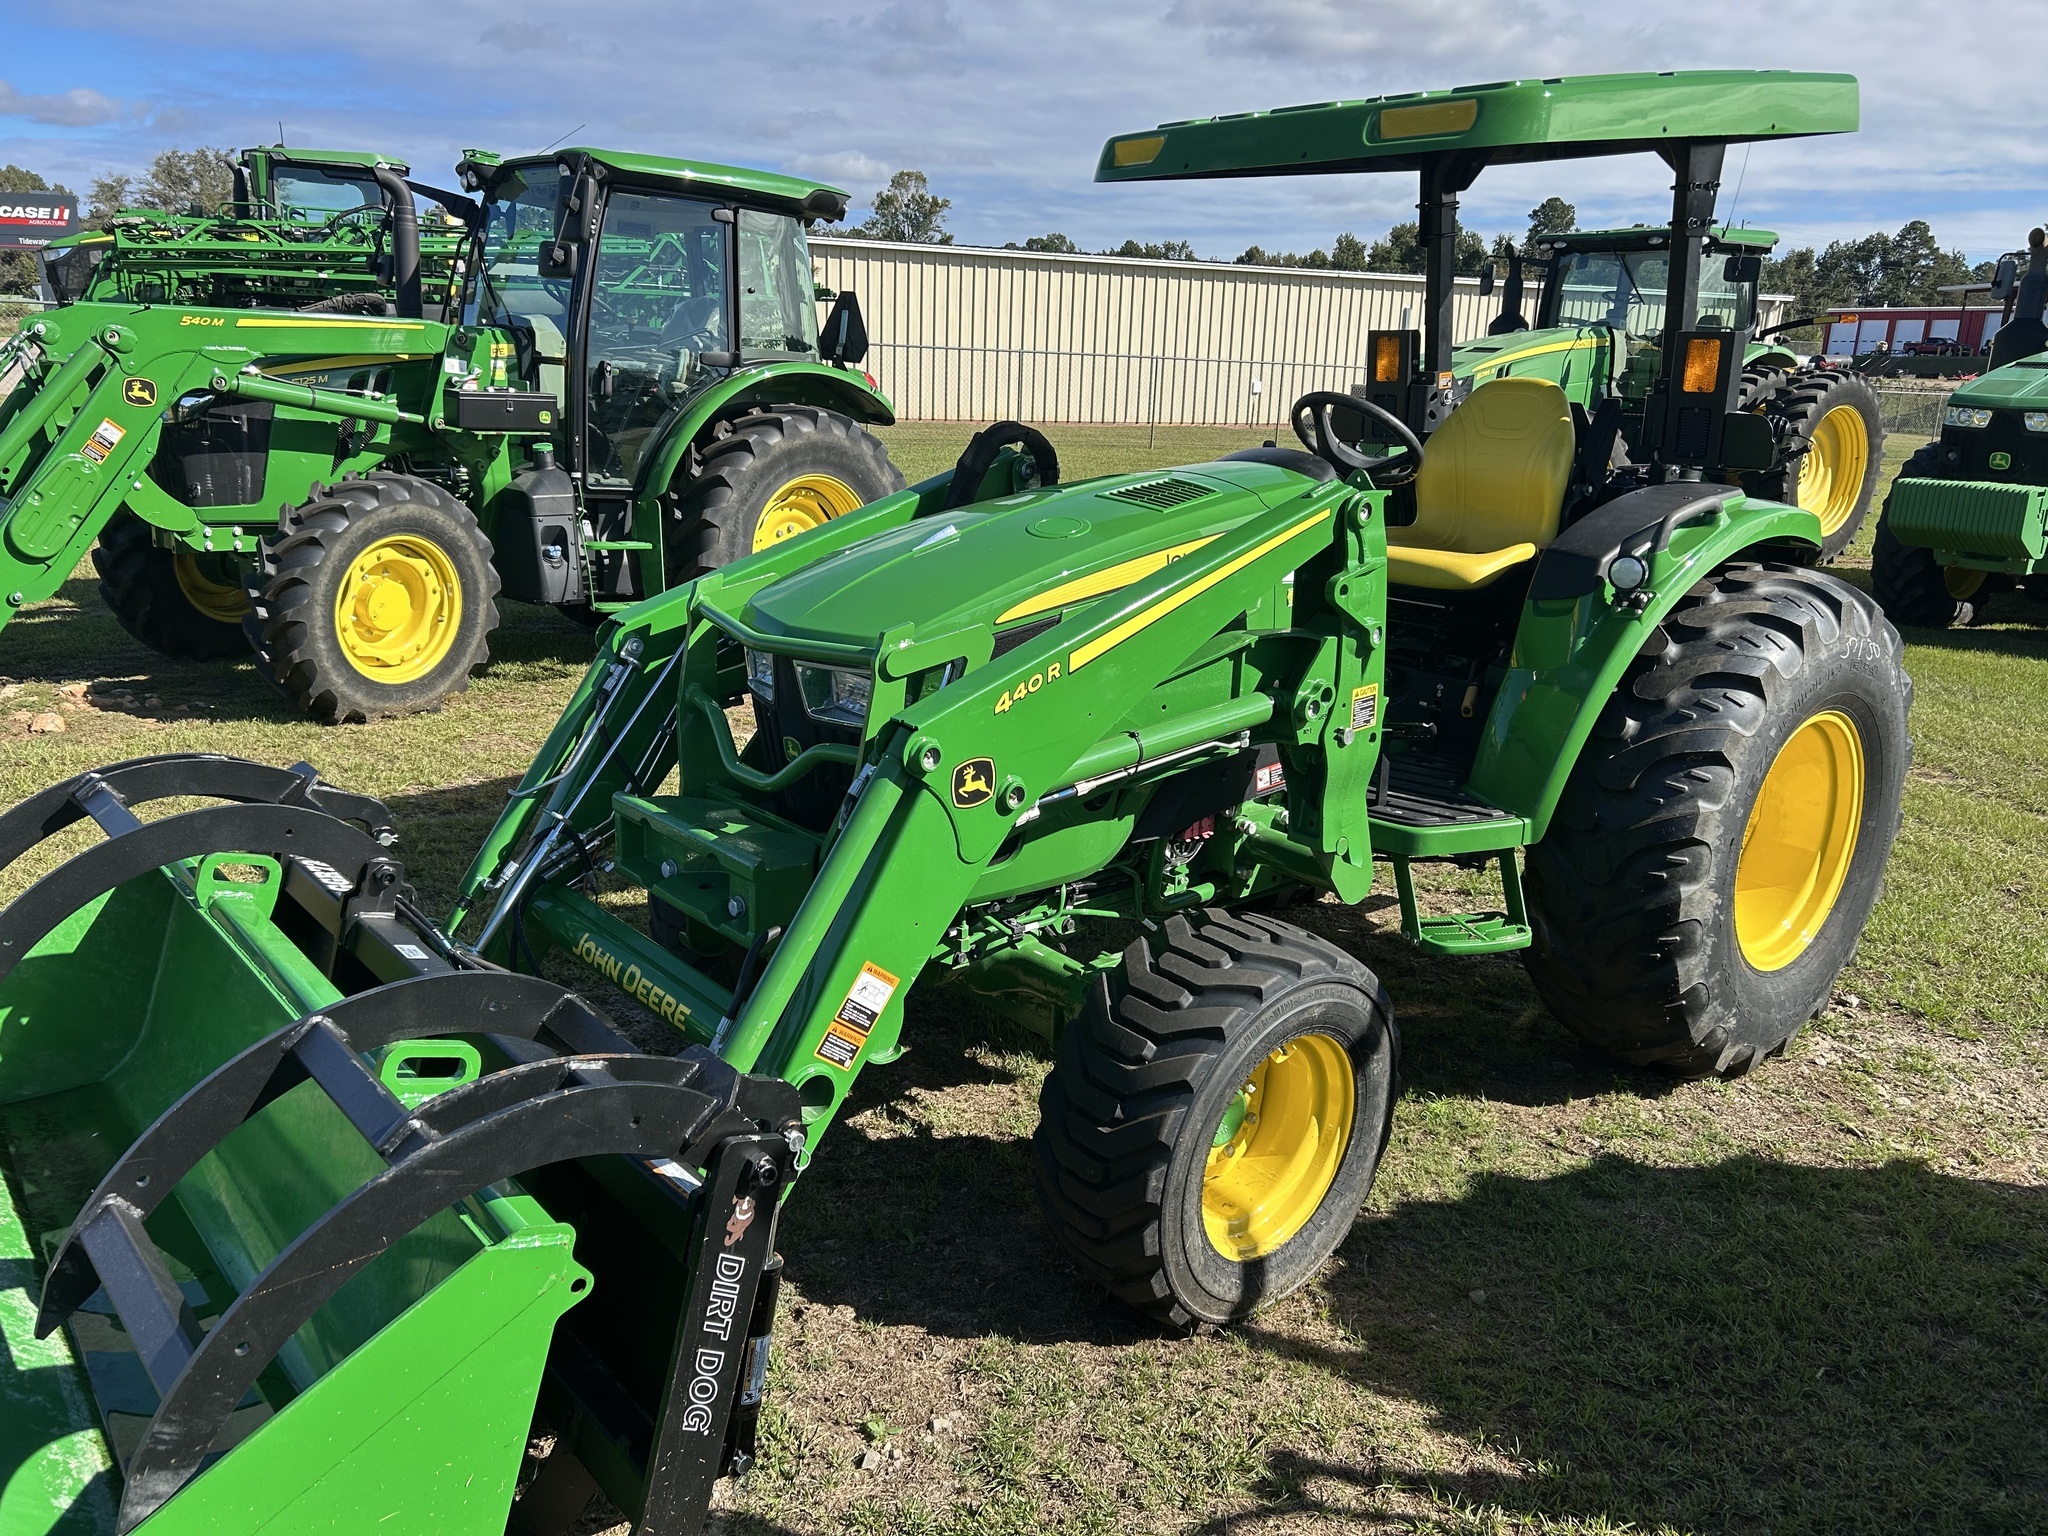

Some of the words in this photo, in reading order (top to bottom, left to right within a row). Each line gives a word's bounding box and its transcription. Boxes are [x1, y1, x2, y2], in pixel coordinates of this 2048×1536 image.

[0, 206, 51, 219] CASE
[179, 315, 211, 327] 540
[211, 317, 225, 327] M
[318, 375, 329, 384] M
[994, 672, 1044, 716] 440
[1047, 661, 1062, 685] R
[1359, 686, 1377, 697] CAUTION
[572, 932, 624, 983] JOHN
[622, 963, 692, 1032] DEERE
[872, 968, 895, 985] WARNING
[838, 1028, 862, 1045] WARNING
[703, 1253, 746, 1341] DIRT
[682, 1348, 725, 1433] DOG
